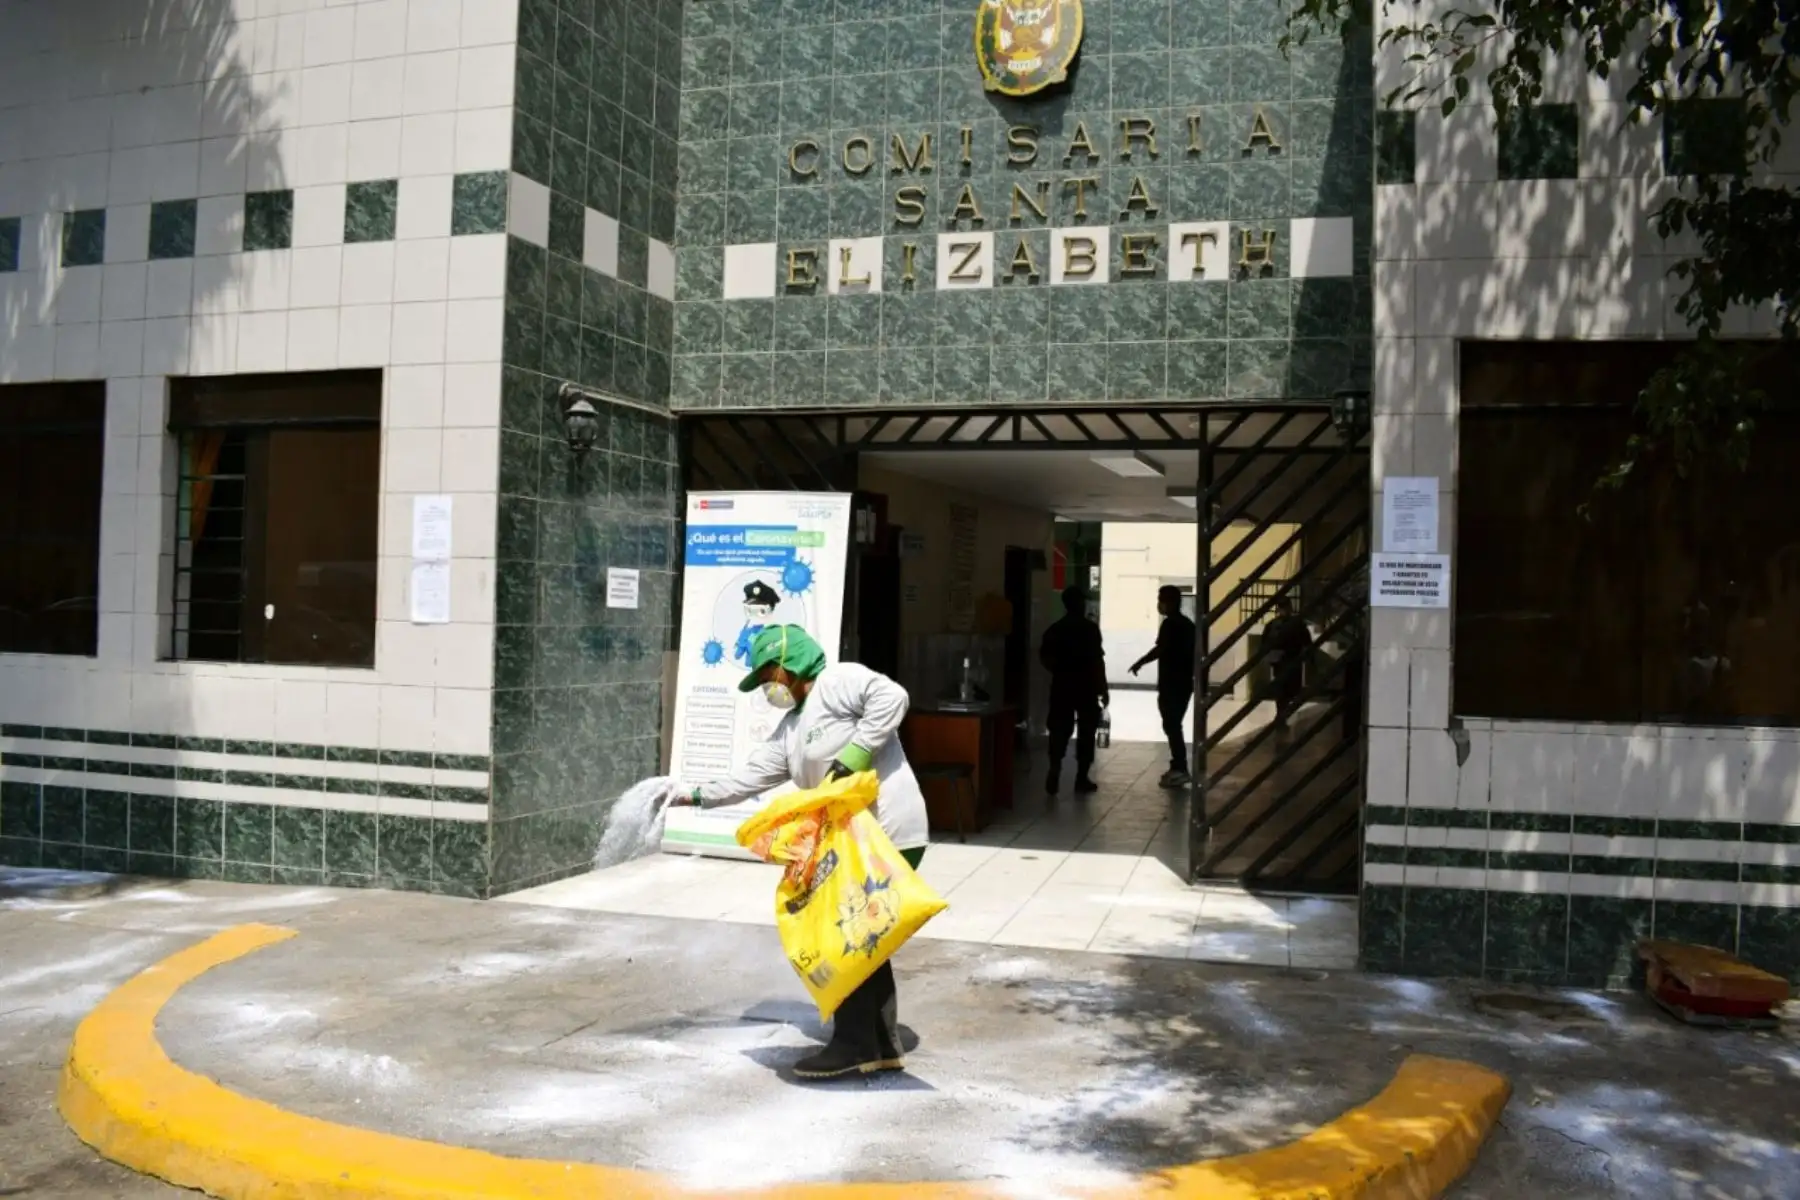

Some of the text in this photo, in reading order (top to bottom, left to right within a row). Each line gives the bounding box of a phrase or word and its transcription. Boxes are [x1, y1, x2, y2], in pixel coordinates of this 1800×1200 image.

[788, 107, 1282, 175] COMISARIA
[895, 176, 1158, 224] SANTA
[787, 229, 1276, 286] ELIZABETH
[688, 531, 717, 546] ¿Qué
[718, 534, 731, 544] es
[732, 532, 744, 544] el
